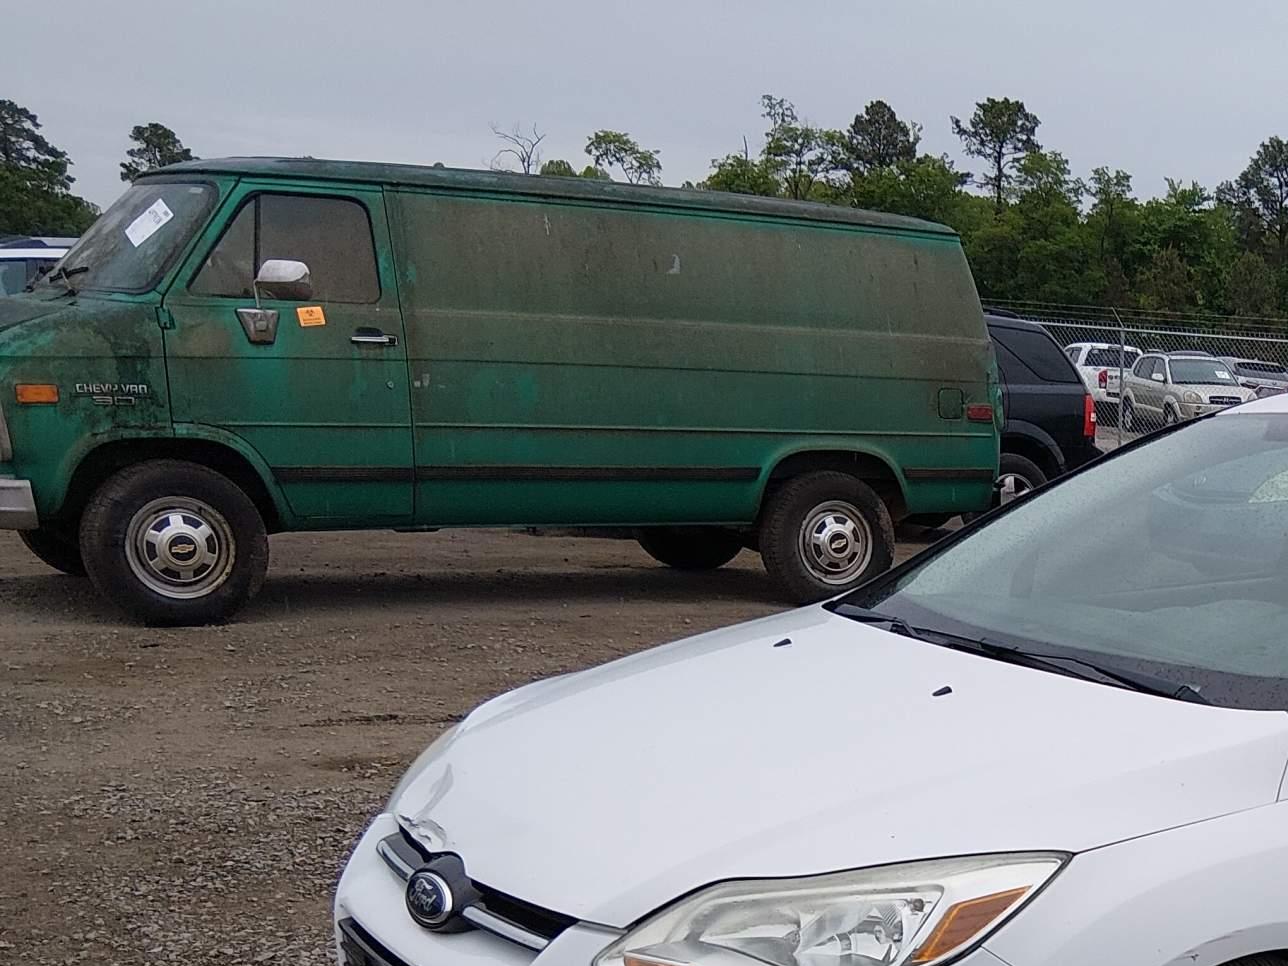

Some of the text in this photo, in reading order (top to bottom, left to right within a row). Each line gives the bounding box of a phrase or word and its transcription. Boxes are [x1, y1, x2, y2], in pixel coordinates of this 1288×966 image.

[120, 384, 148, 393] VAN
[92, 395, 135, 405] 30
[410, 878, 437, 912] Ford
